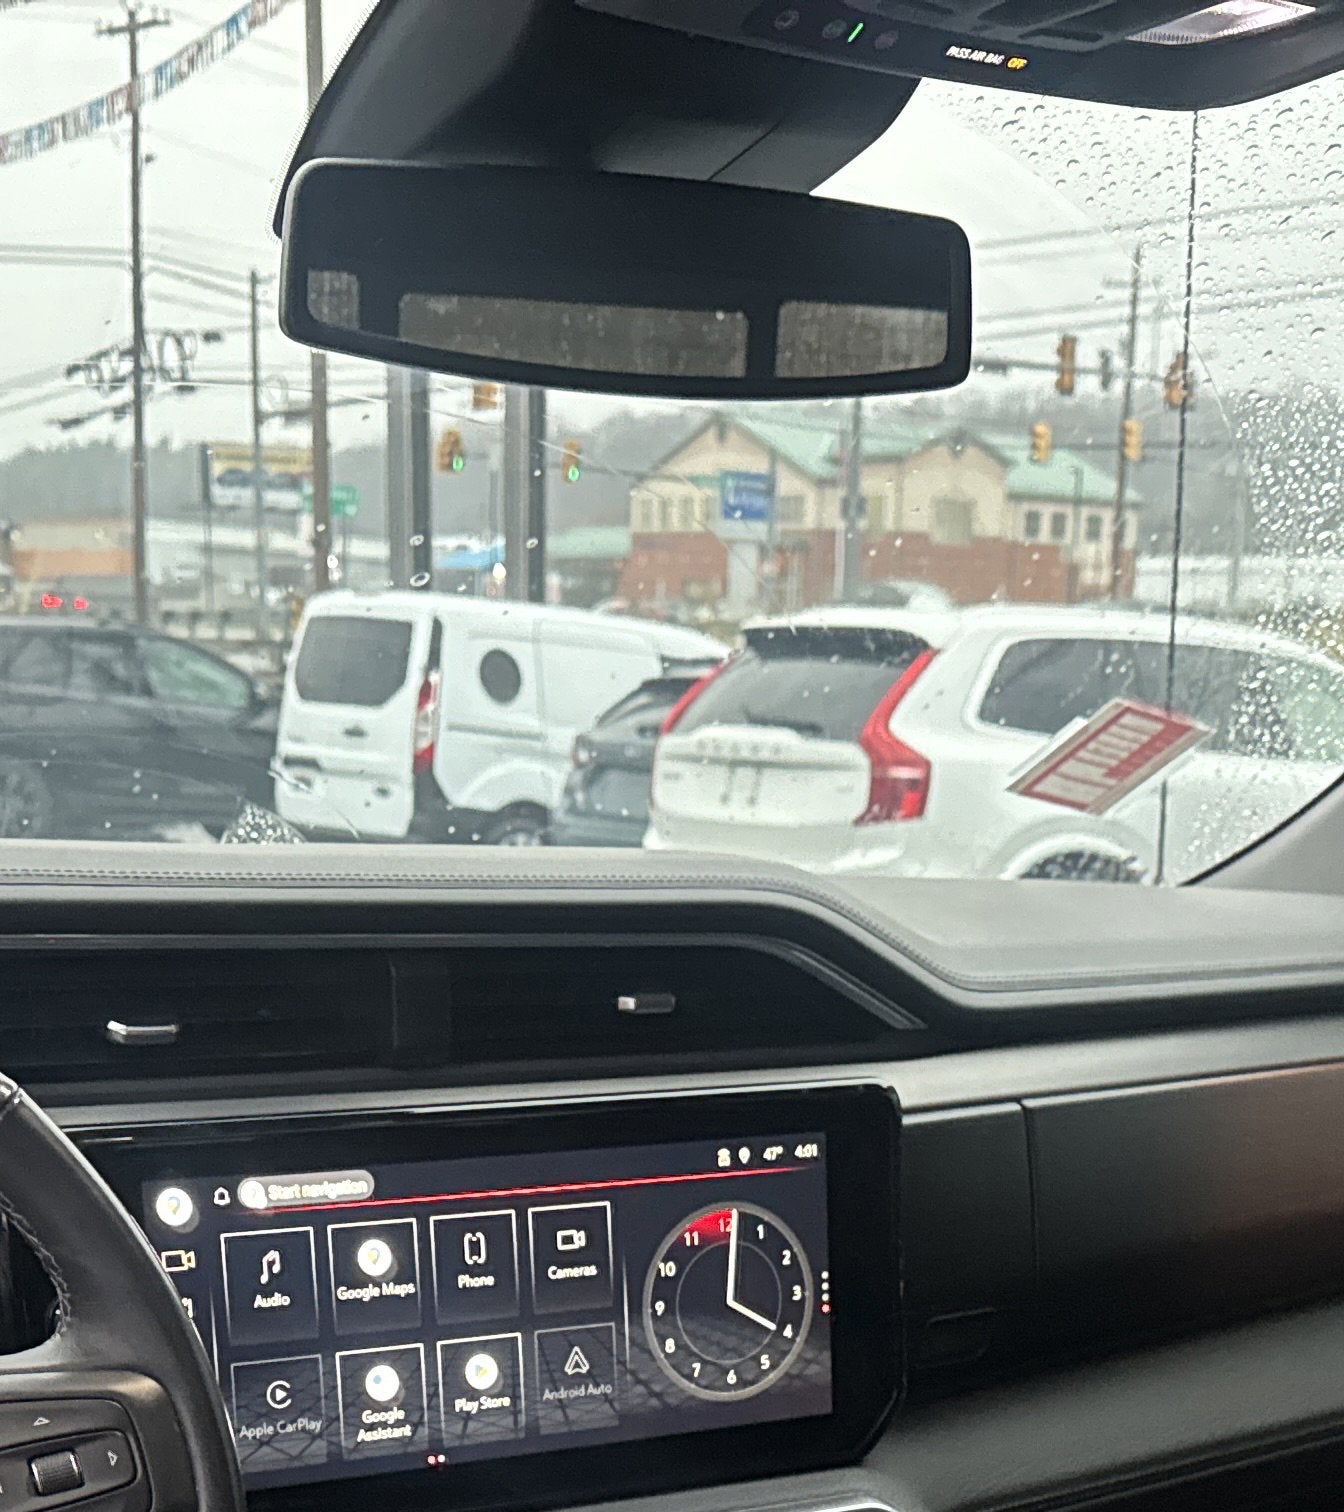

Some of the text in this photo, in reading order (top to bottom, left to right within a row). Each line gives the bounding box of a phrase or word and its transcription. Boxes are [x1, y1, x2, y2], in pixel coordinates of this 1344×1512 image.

[945, 45, 1028, 69] PASS AIR BAG OFF
[268, 1180, 369, 1201] Start navigation
[684, 1231, 699, 1247] 11
[757, 1224, 765, 1240] 1
[782, 1249, 792, 1265] 2
[547, 1264, 598, 1280] Cameras
[659, 1260, 676, 1277] 10
[458, 1274, 495, 1288] Phone
[253, 1292, 291, 1308] Audio
[336, 1282, 416, 1301] Google Maps
[792, 1284, 802, 1301] 3
[654, 1300, 665, 1316] 9
[782, 1323, 793, 1339] 4
[664, 1337, 676, 1354] 8
[692, 1362, 701, 1378] 7
[760, 1354, 771, 1370] 5
[727, 1368, 737, 1385] 6
[542, 1383, 613, 1401] Android Auto
[454, 1395, 511, 1414] Play Store
[361, 1407, 406, 1424] Google
[239, 1417, 322, 1440] Apple CarPlay
[357, 1424, 413, 1442] Assistant
